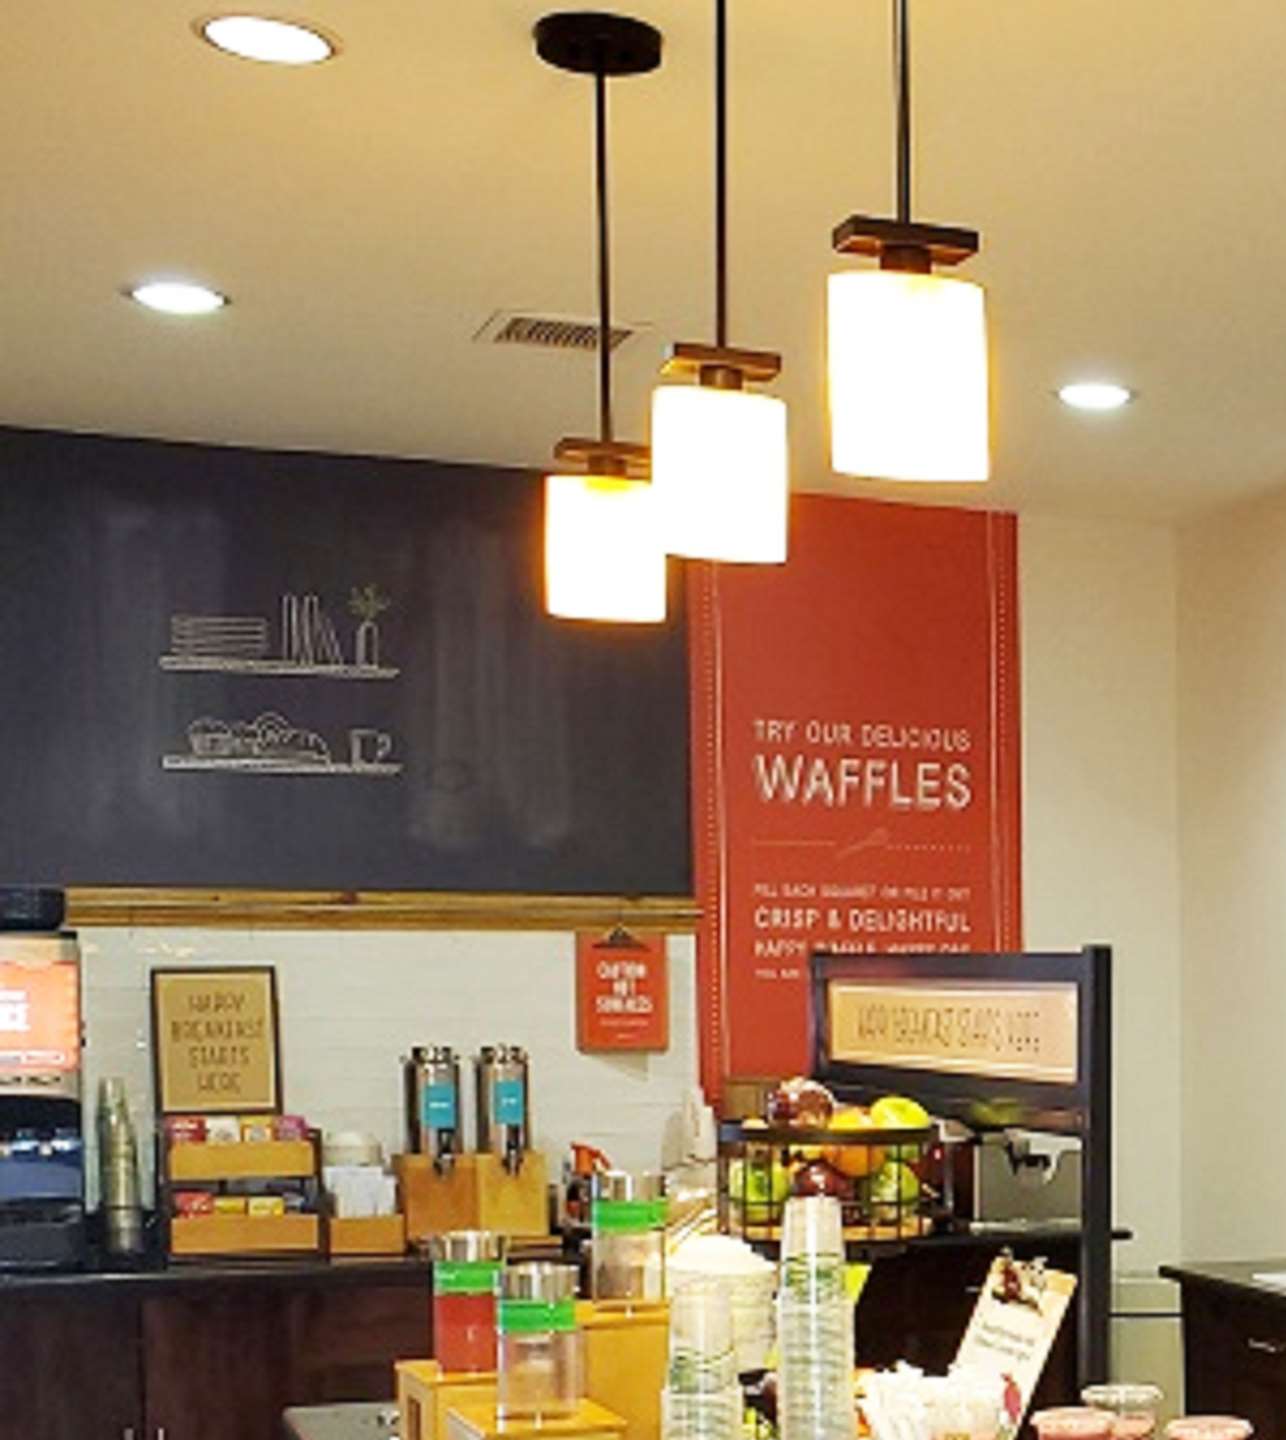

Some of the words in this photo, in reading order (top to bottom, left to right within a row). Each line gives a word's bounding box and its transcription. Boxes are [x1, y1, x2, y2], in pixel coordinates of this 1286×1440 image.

[754, 719, 796, 743] TRY
[805, 720, 852, 746] OUR
[860, 724, 972, 752] DELICIOUS
[755, 752, 972, 811] WAFFLES
[755, 906, 819, 930] CRISP
[826, 907, 843, 930] &
[849, 908, 972, 934] DELIGHTFUL
[188, 991, 246, 1013] HAPPY
[171, 1018, 263, 1043] BREAKFAST
[188, 1044, 250, 1069] STARTS
[198, 1070, 242, 1095] HERE
